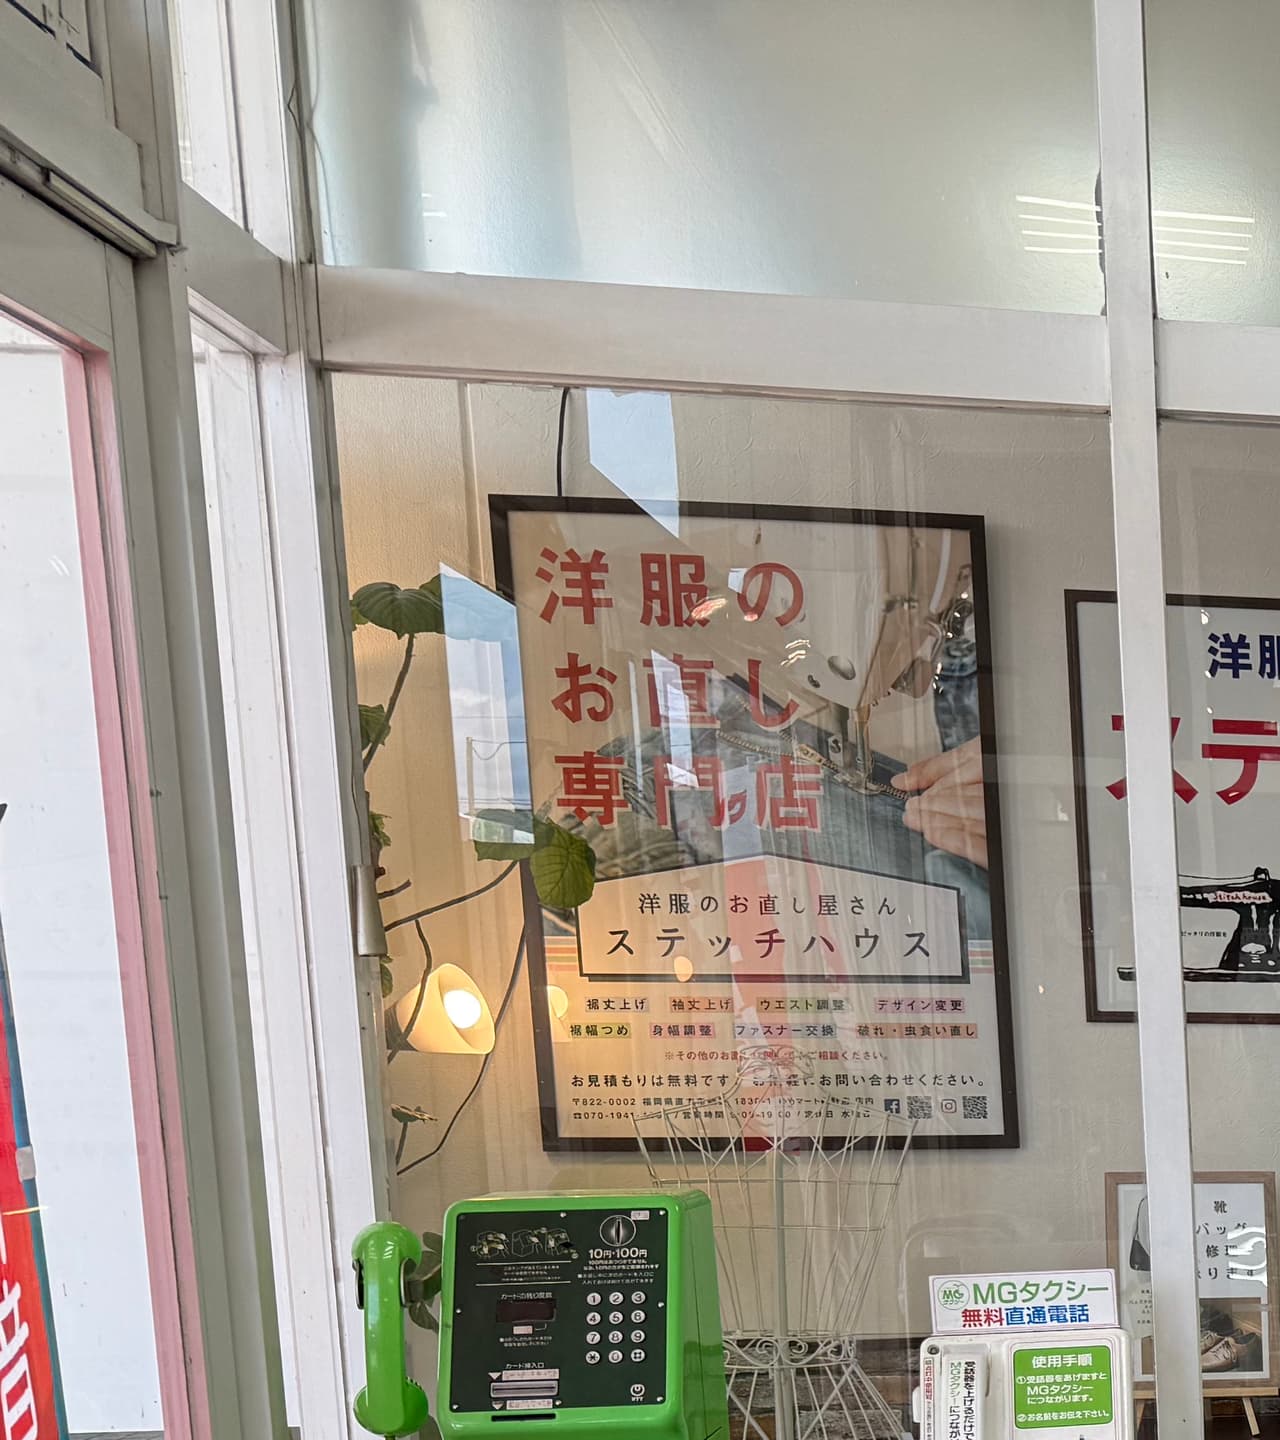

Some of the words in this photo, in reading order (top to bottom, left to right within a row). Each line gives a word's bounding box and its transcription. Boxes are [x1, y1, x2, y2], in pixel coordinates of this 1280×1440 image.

[535, 547, 805, 628] 洋服の
[551, 652, 800, 729] お直し
[554, 750, 825, 832] 専門店
[637, 892, 898, 917] 洋服のお直し屋さん
[606, 927, 932, 959] ステッチハウス
[877, 999, 965, 1012] デザイン変更
[1213, 1200, 1228, 1214] 靴
[972, 1280, 1109, 1305] MGタクシー
[961, 1303, 1090, 1328] 無料直通電話
[1032, 1353, 1093, 1369] 使用手順
[1026, 1384, 1094, 1396] MGタクシー
[1027, 1394, 1094, 1405] につながります。
